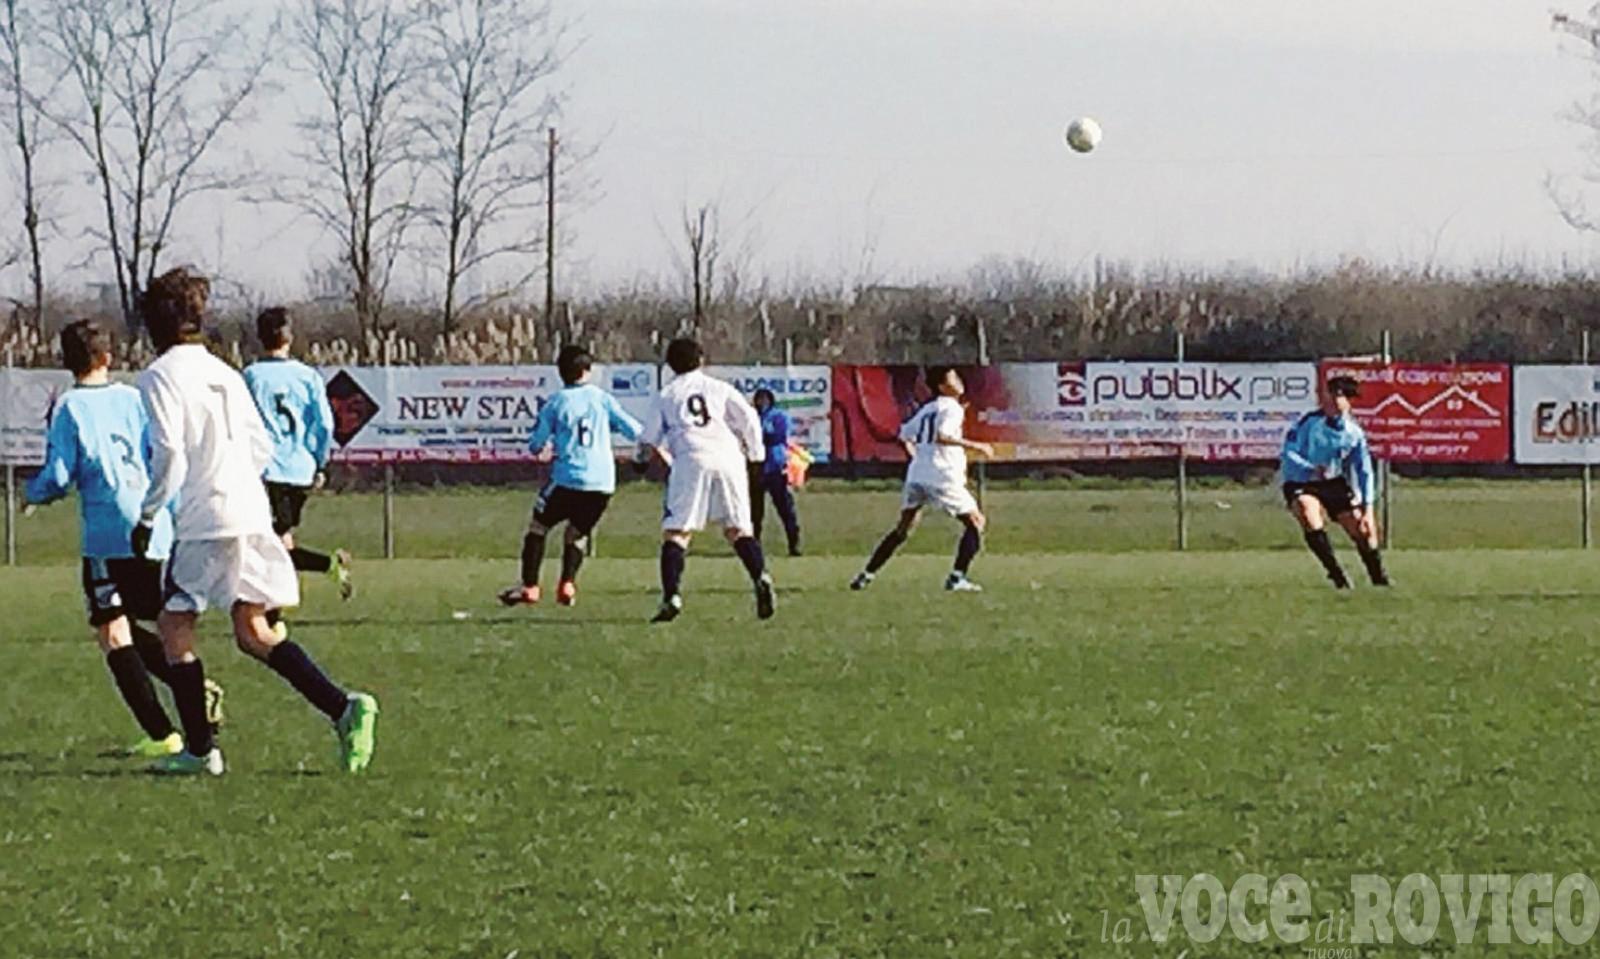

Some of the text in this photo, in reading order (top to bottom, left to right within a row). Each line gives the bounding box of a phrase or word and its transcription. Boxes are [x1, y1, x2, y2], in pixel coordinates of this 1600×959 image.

[209, 383, 233, 441] 7
[273, 391, 297, 437] 5
[397, 396, 470, 421] NEW
[686, 393, 712, 428] 9
[577, 415, 594, 448] 6
[915, 410, 938, 444] 11
